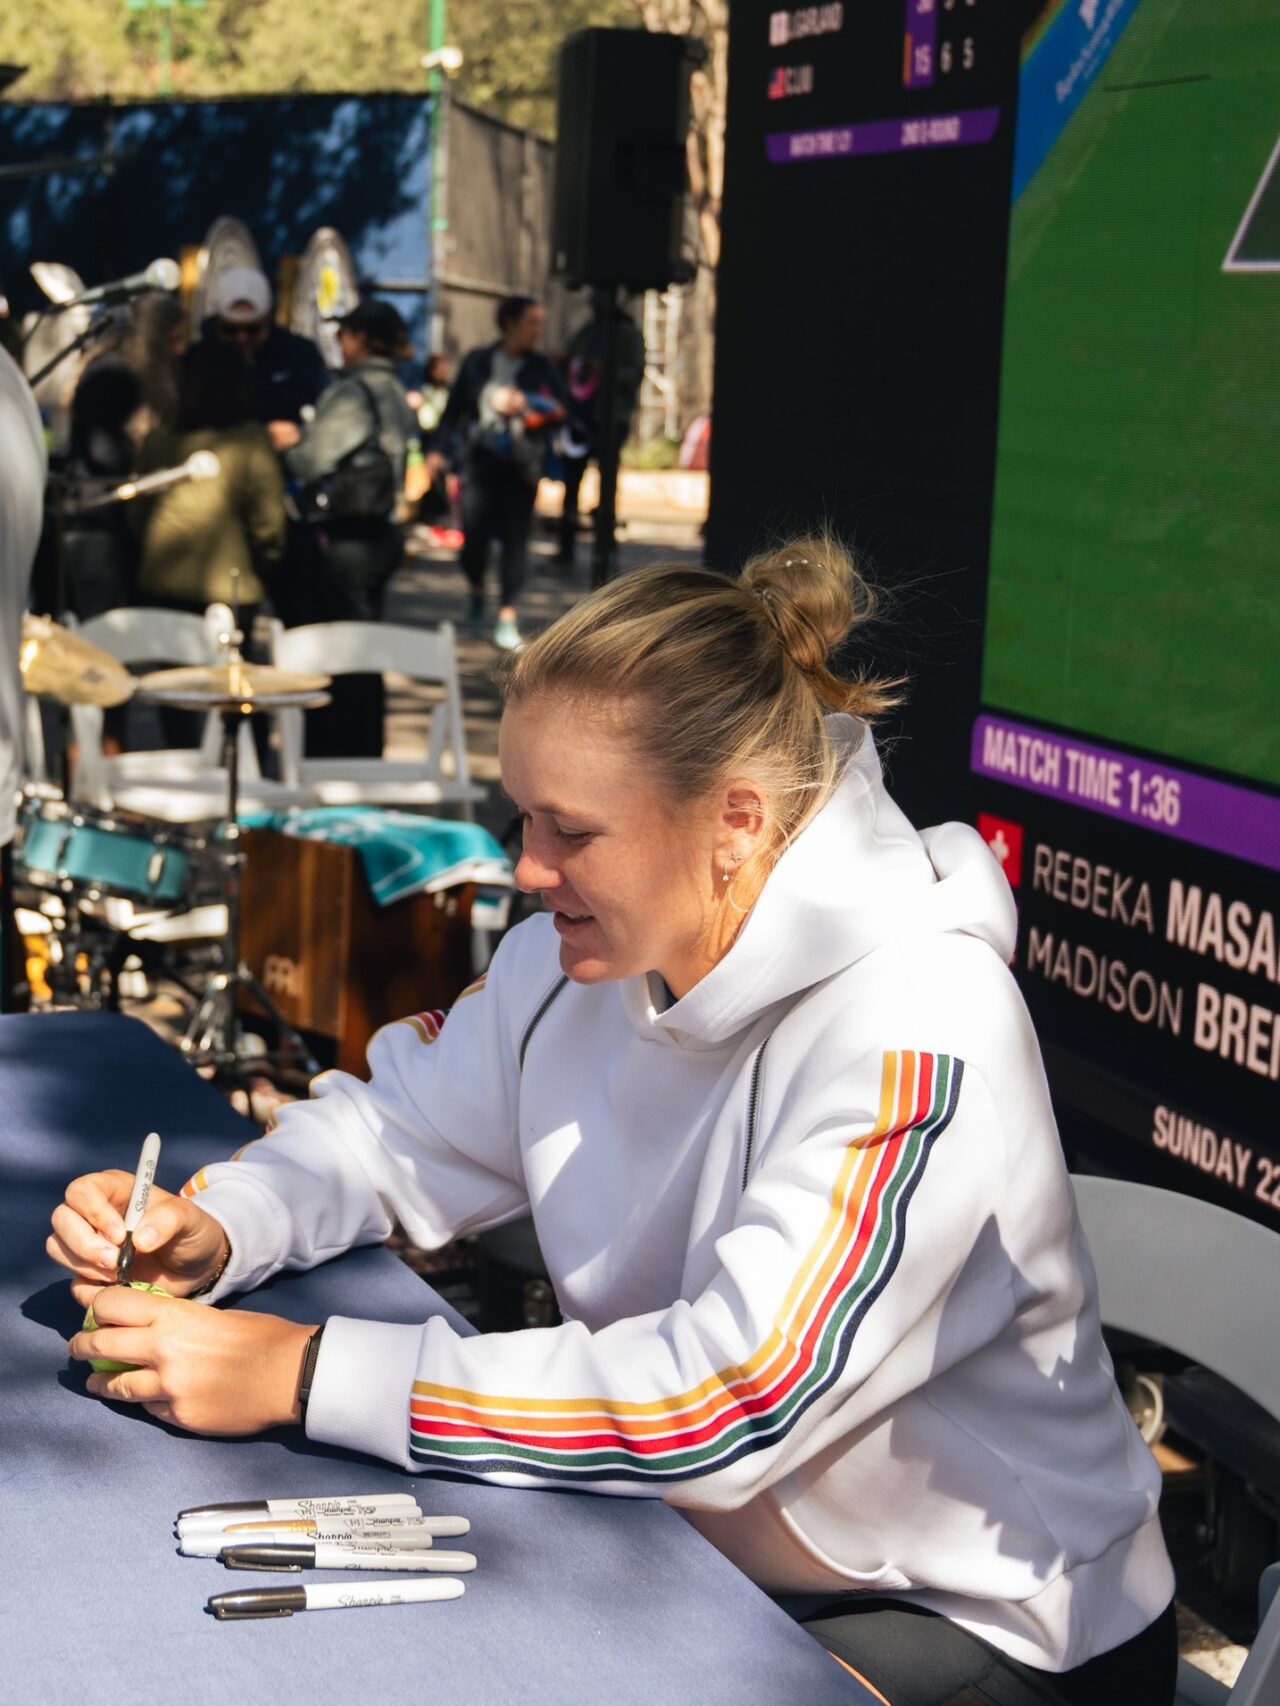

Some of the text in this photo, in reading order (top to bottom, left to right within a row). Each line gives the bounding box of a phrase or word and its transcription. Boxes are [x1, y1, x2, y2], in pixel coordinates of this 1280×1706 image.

[914, 42, 932, 77] 15
[983, 725, 1181, 827] MATCH TIME 1:36
[1033, 843, 1280, 985] REBEKA MASA
[1027, 926, 1184, 1036] MADISON
[1152, 1105, 1252, 1189] SUNDAY
